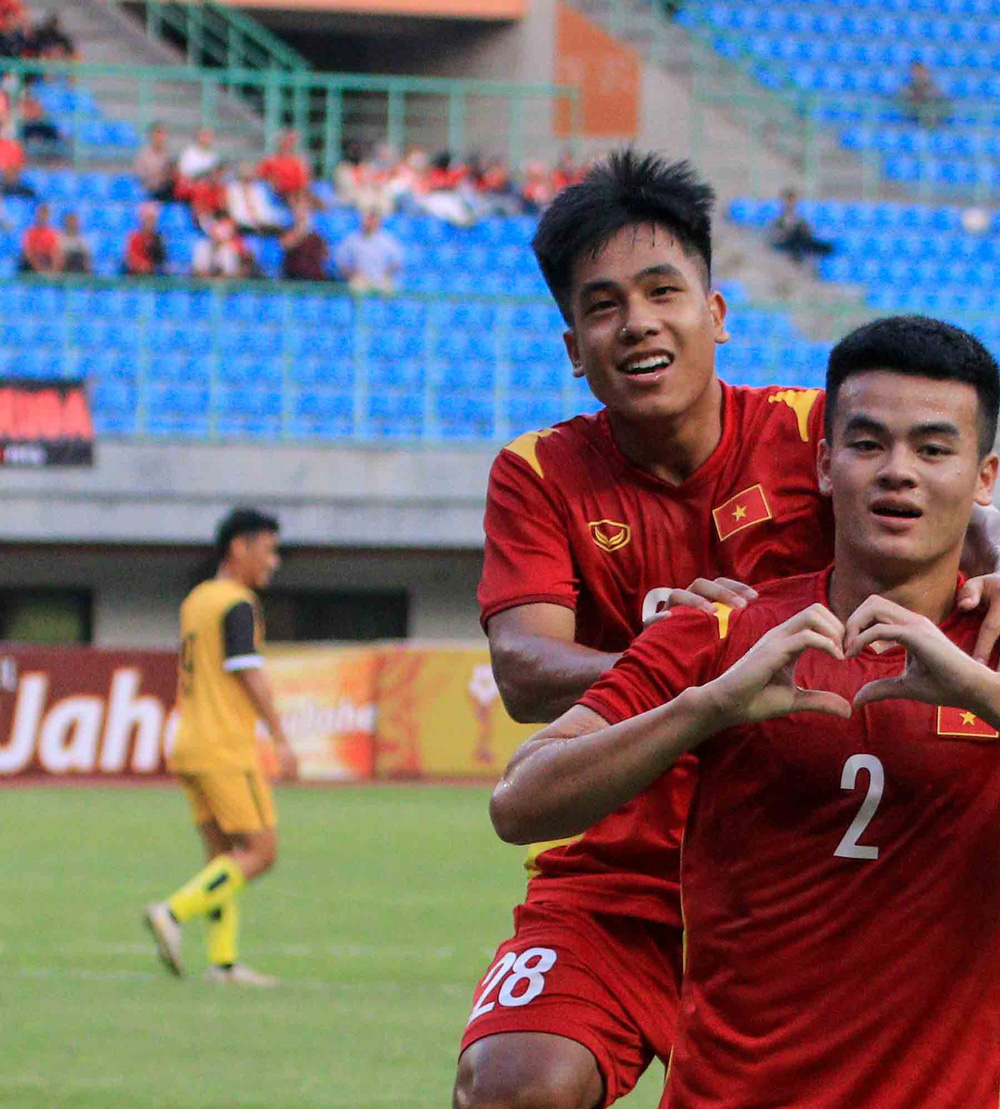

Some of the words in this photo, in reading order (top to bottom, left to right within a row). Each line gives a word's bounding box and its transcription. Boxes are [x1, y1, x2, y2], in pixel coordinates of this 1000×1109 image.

[0, 667, 180, 773] Jah
[833, 753, 885, 860] 2
[467, 947, 557, 1026] 28
